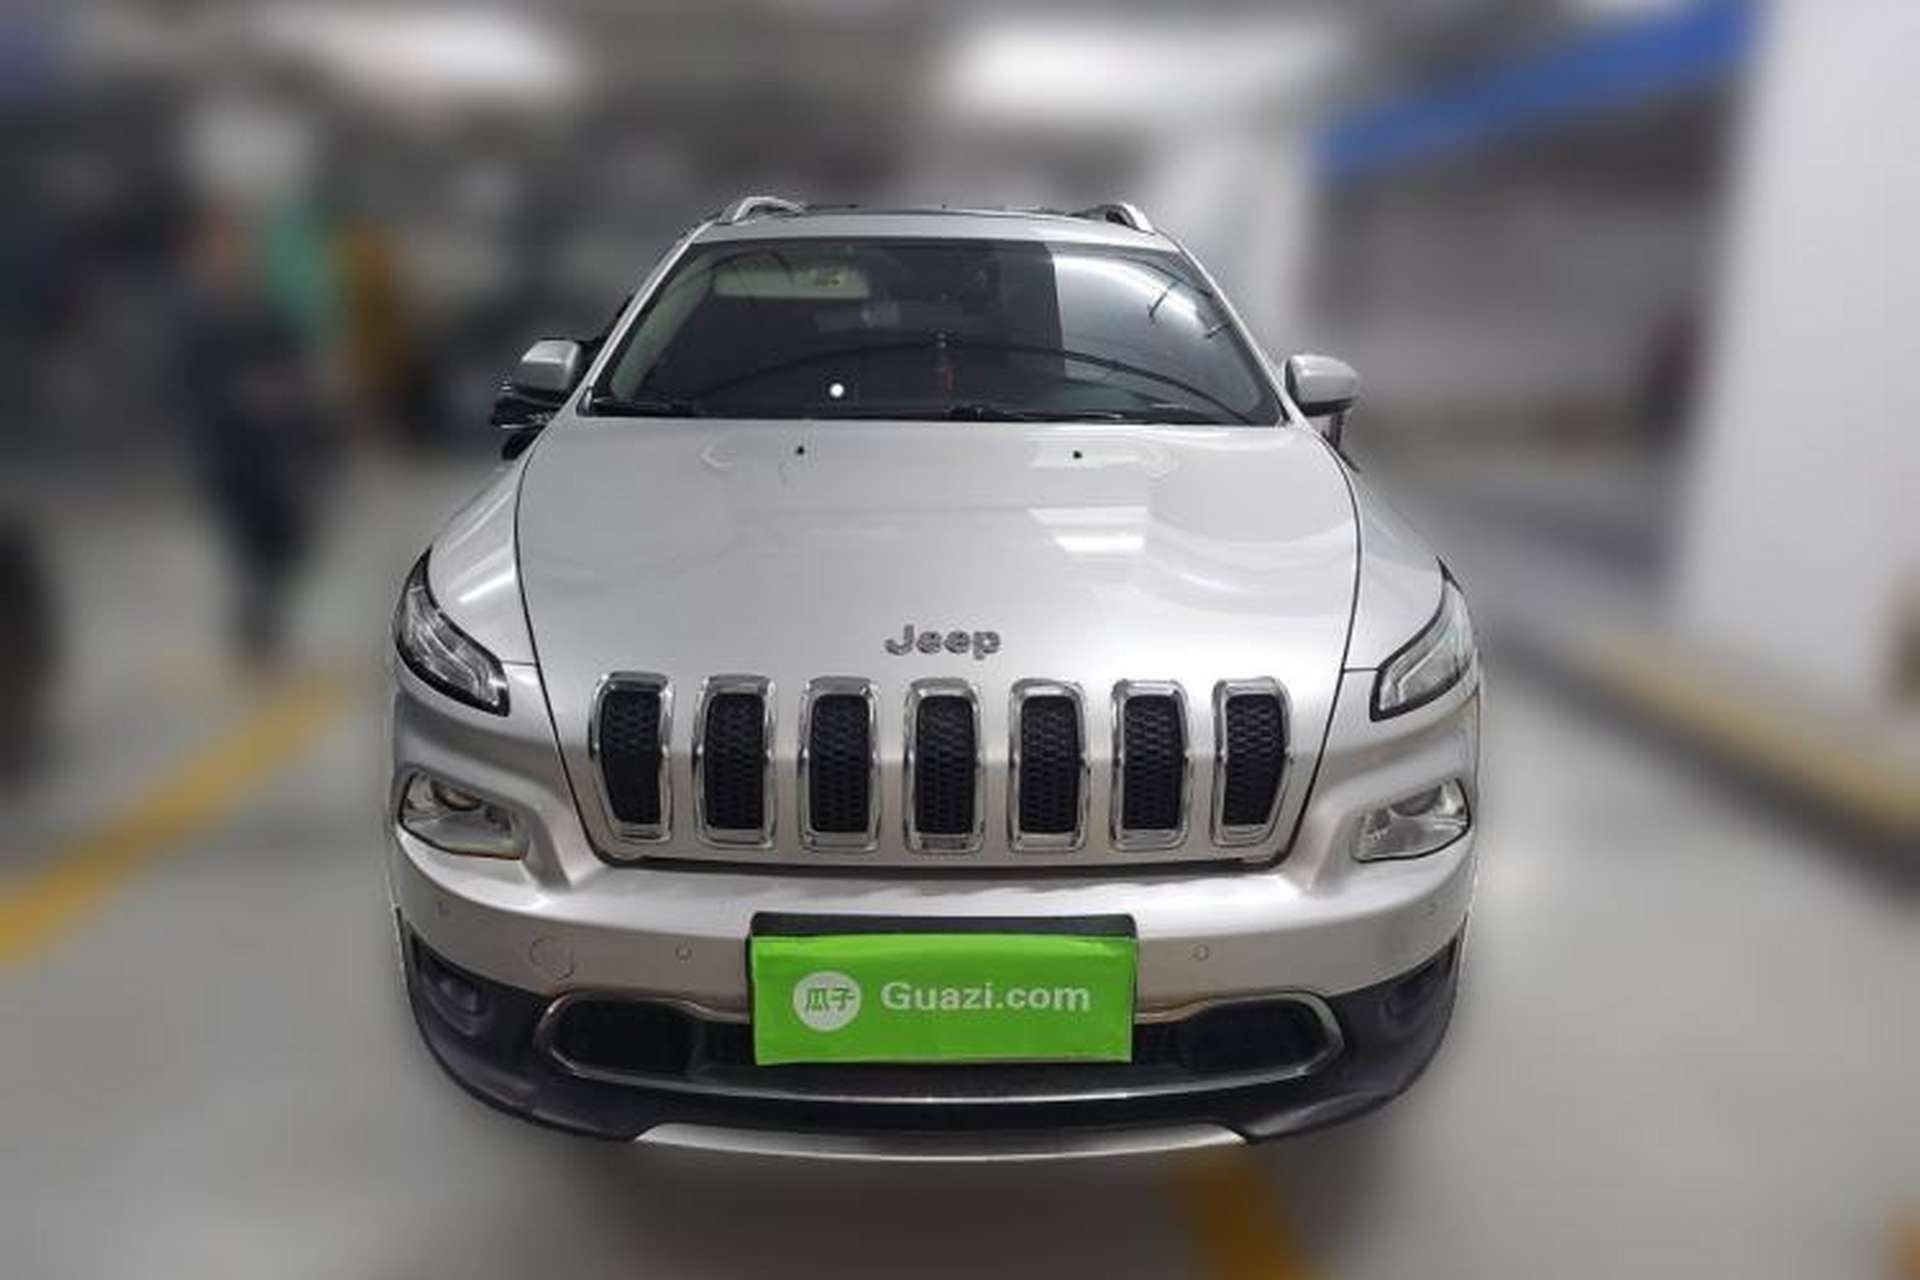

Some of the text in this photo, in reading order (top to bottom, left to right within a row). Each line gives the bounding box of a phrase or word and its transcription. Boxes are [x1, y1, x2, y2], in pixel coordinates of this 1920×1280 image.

[884, 624, 1001, 660] Jeep
[805, 986, 856, 1012] 瓜子
[880, 981, 1092, 1012] Guazi.com
